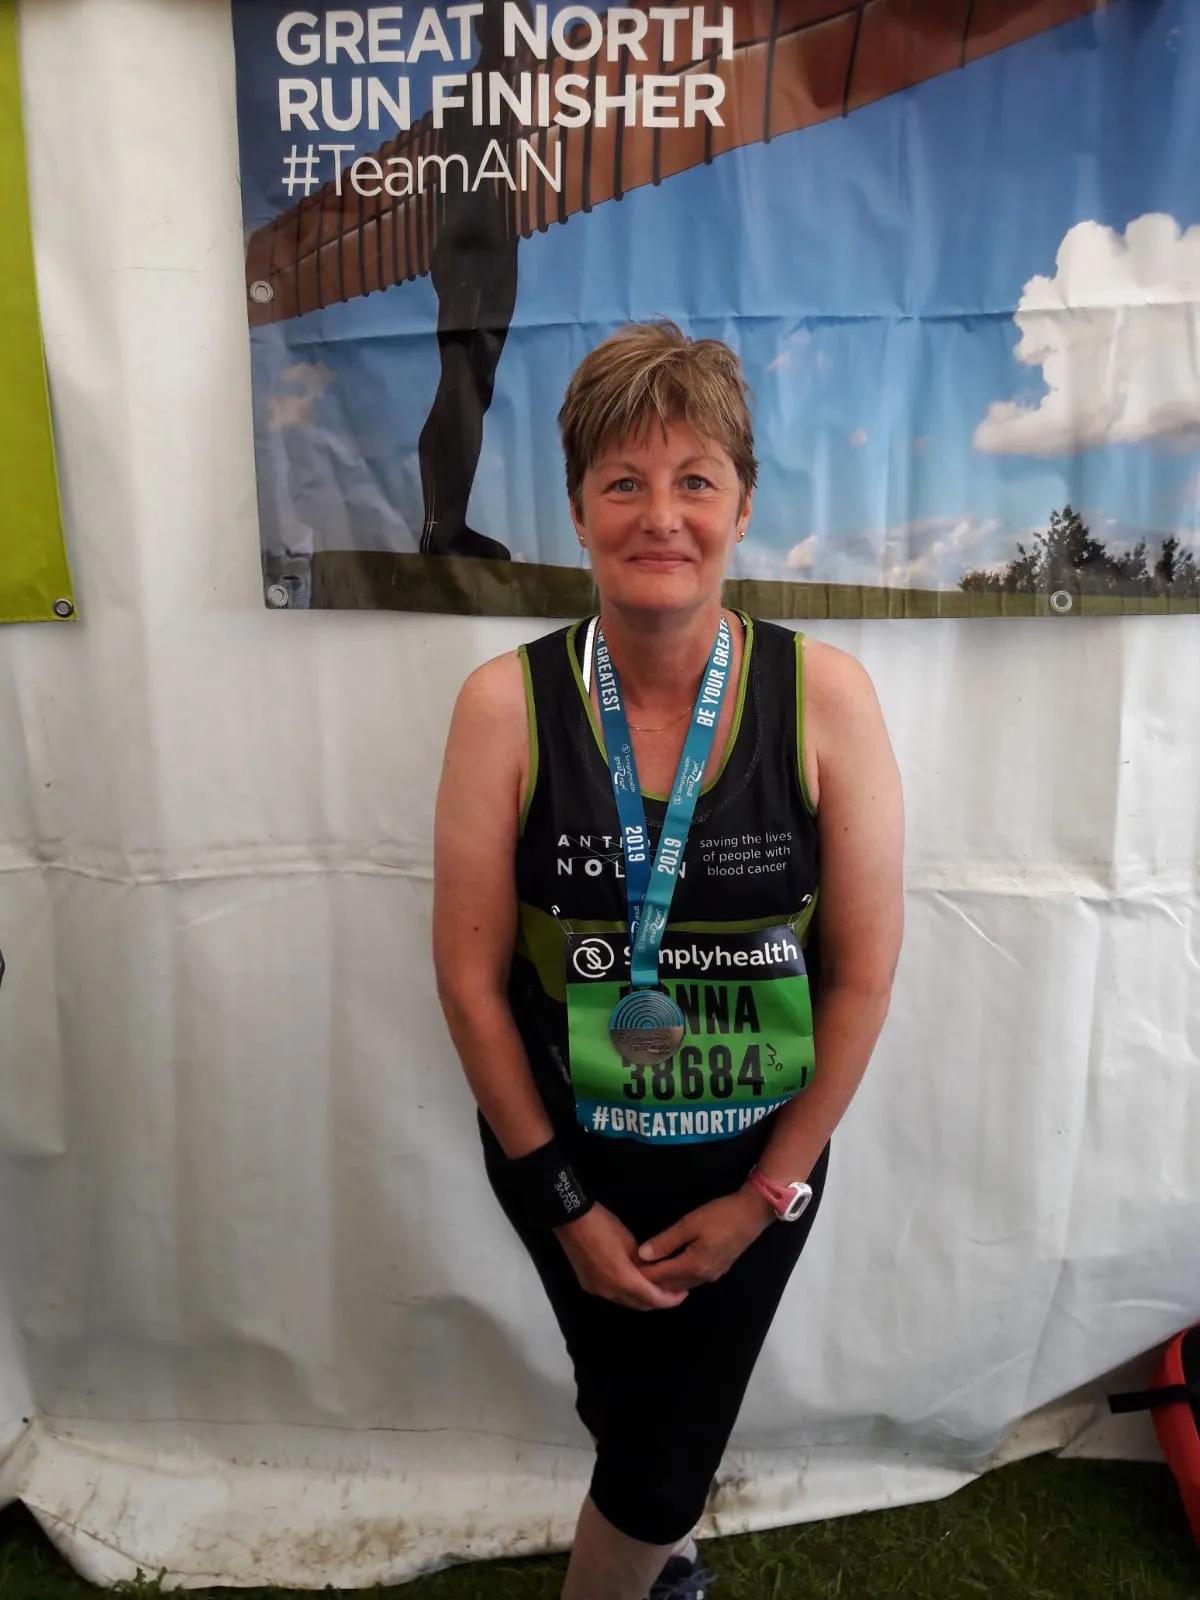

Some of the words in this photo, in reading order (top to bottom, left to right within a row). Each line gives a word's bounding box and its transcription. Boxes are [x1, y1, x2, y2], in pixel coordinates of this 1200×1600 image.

[276, 3, 484, 66] GREAT
[502, 3, 734, 63] NORTH
[278, 75, 411, 133] RUN
[431, 71, 727, 129] FINISHER
[281, 138, 562, 198] #TeamAN
[596, 646, 621, 712] GREATEST
[701, 669, 726, 706] YOUR
[696, 707, 716, 728] BE
[625, 825, 646, 862] 2019
[656, 837, 682, 876] 2019
[699, 835, 738, 848] saving
[741, 833, 762, 845] the
[765, 831, 792, 844] lives
[702, 850, 716, 862] of
[719, 848, 761, 864] people
[765, 845, 791, 858] with
[707, 863, 744, 876] blood
[747, 861, 787, 874] cancer
[623, 939, 798, 971] Smplyhealth
[619, 983, 760, 1035] NNA
[622, 1043, 765, 1100] 38684
[593, 1098, 791, 1137] #GREATNORTHR
[559, 1171, 571, 1191] THIS
[568, 1190, 581, 1208] GOT
